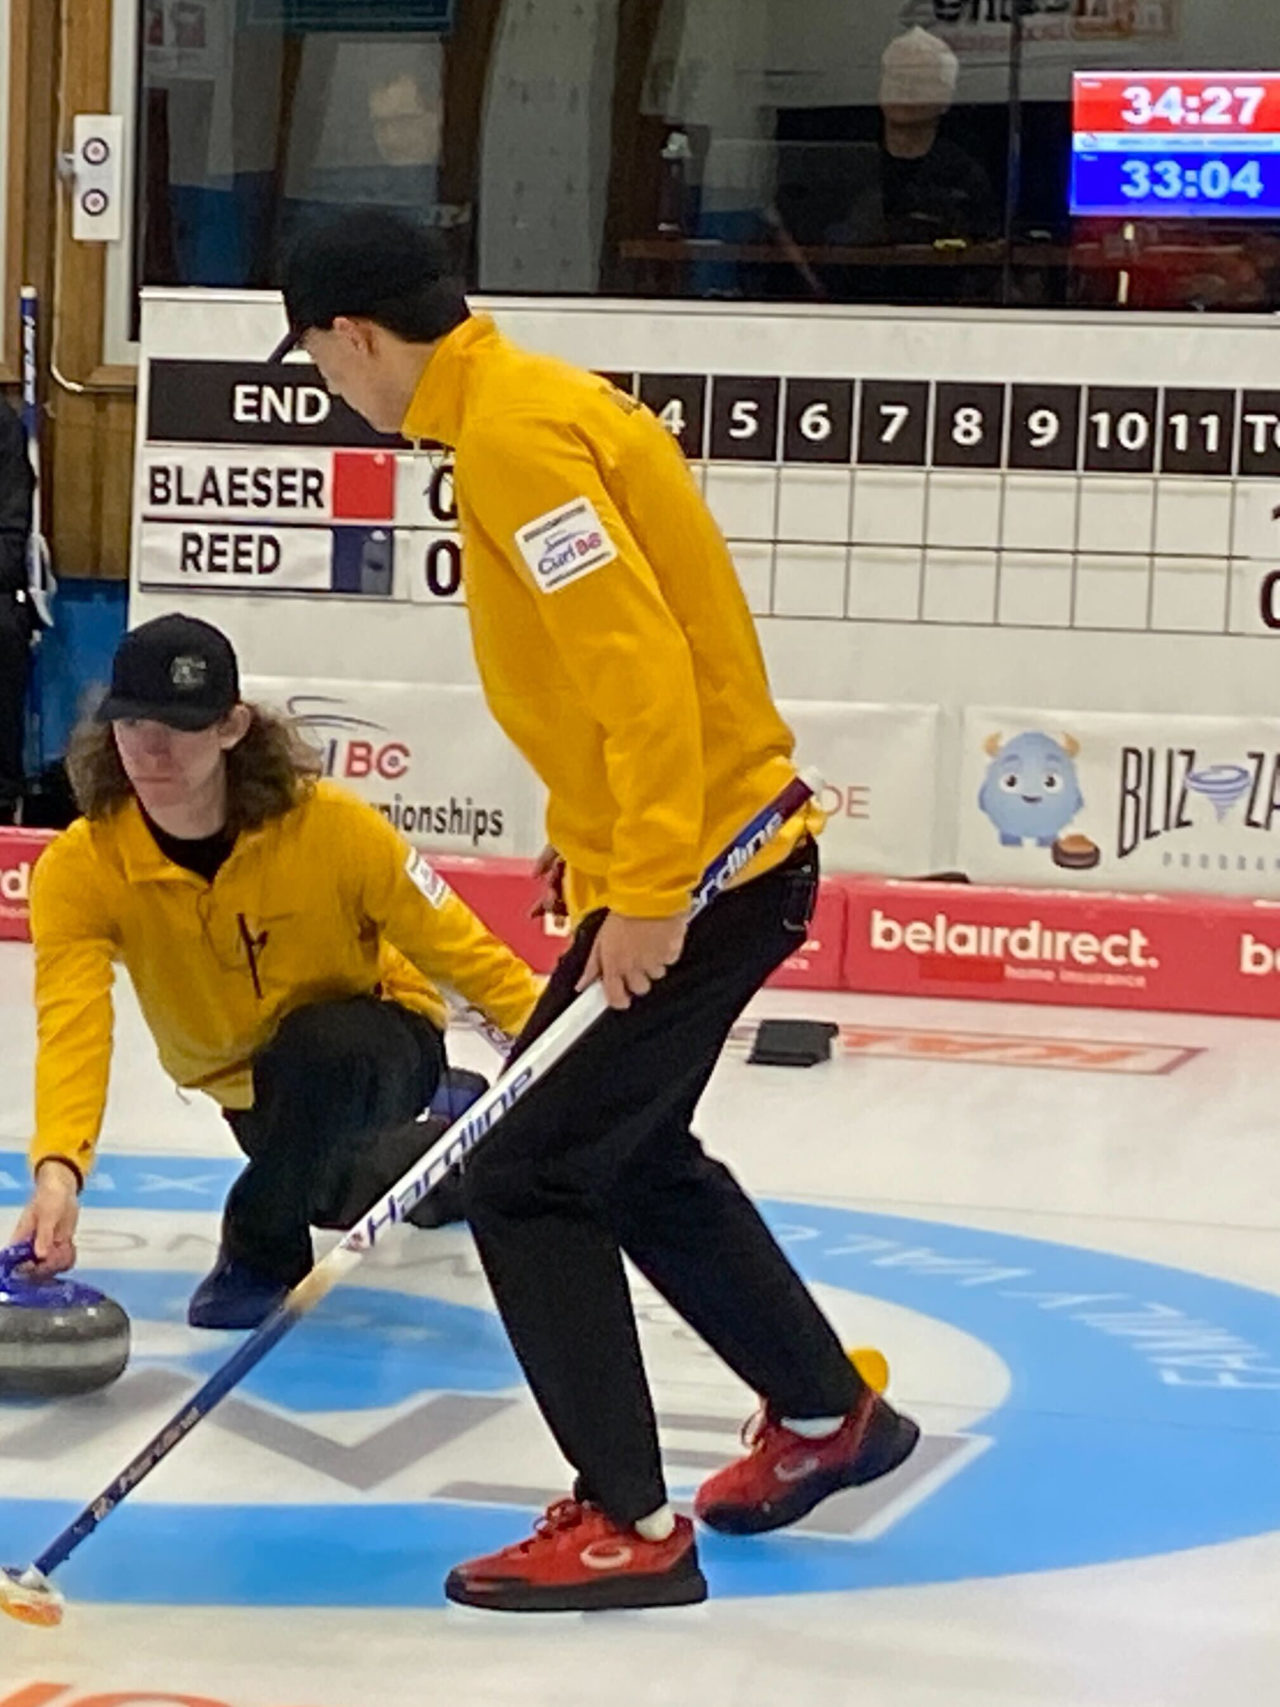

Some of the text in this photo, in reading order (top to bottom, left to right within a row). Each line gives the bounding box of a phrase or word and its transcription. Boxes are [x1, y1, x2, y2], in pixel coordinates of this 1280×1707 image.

[1121, 86, 1266, 125] 34:27
[1121, 160, 1264, 199] 33:04
[233, 383, 331, 425] END
[728, 400, 759, 440] 5
[799, 403, 832, 442] 6
[879, 404, 910, 444] 7
[951, 407, 984, 447] 8
[1027, 408, 1060, 448] 9
[1090, 410, 1150, 451] 10
[1169, 413, 1220, 453] 11
[148, 464, 326, 510] BLAESER
[181, 532, 461, 597] REED 0
[343, 739, 411, 780] BC
